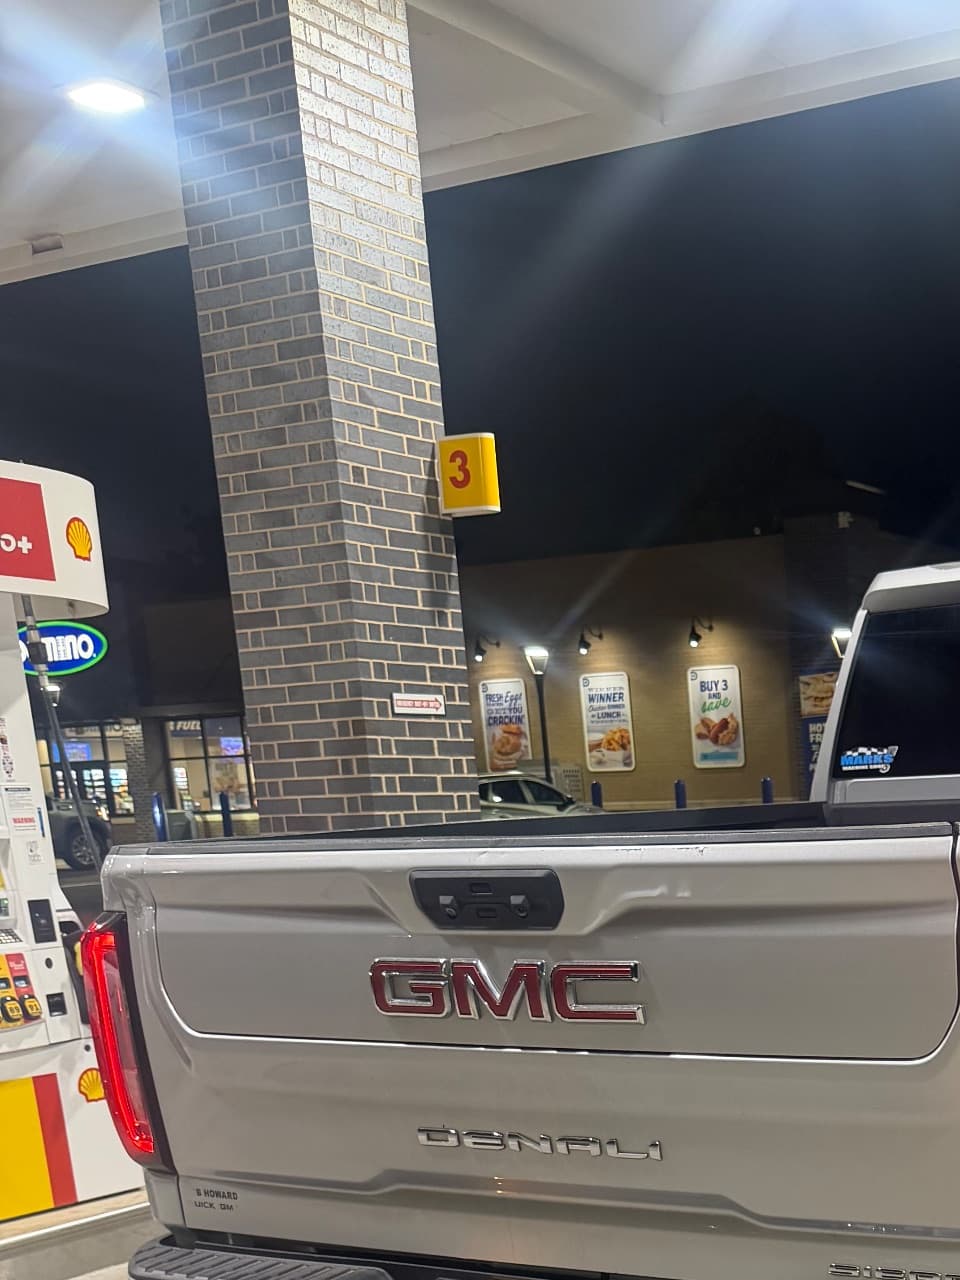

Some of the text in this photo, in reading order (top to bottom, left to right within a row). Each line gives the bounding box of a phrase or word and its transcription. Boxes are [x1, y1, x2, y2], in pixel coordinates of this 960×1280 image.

[449, 449, 471, 489] 3
[700, 679, 729, 692] BUY 3
[588, 692, 625, 704] WINNER
[707, 692, 721, 700] AND
[597, 711, 621, 719] LUNCH
[840, 753, 894, 766] MARKS
[369, 957, 647, 1025] GMC
[416, 1126, 664, 1162] DENALI
[204, 1189, 238, 1200] HOWARD
